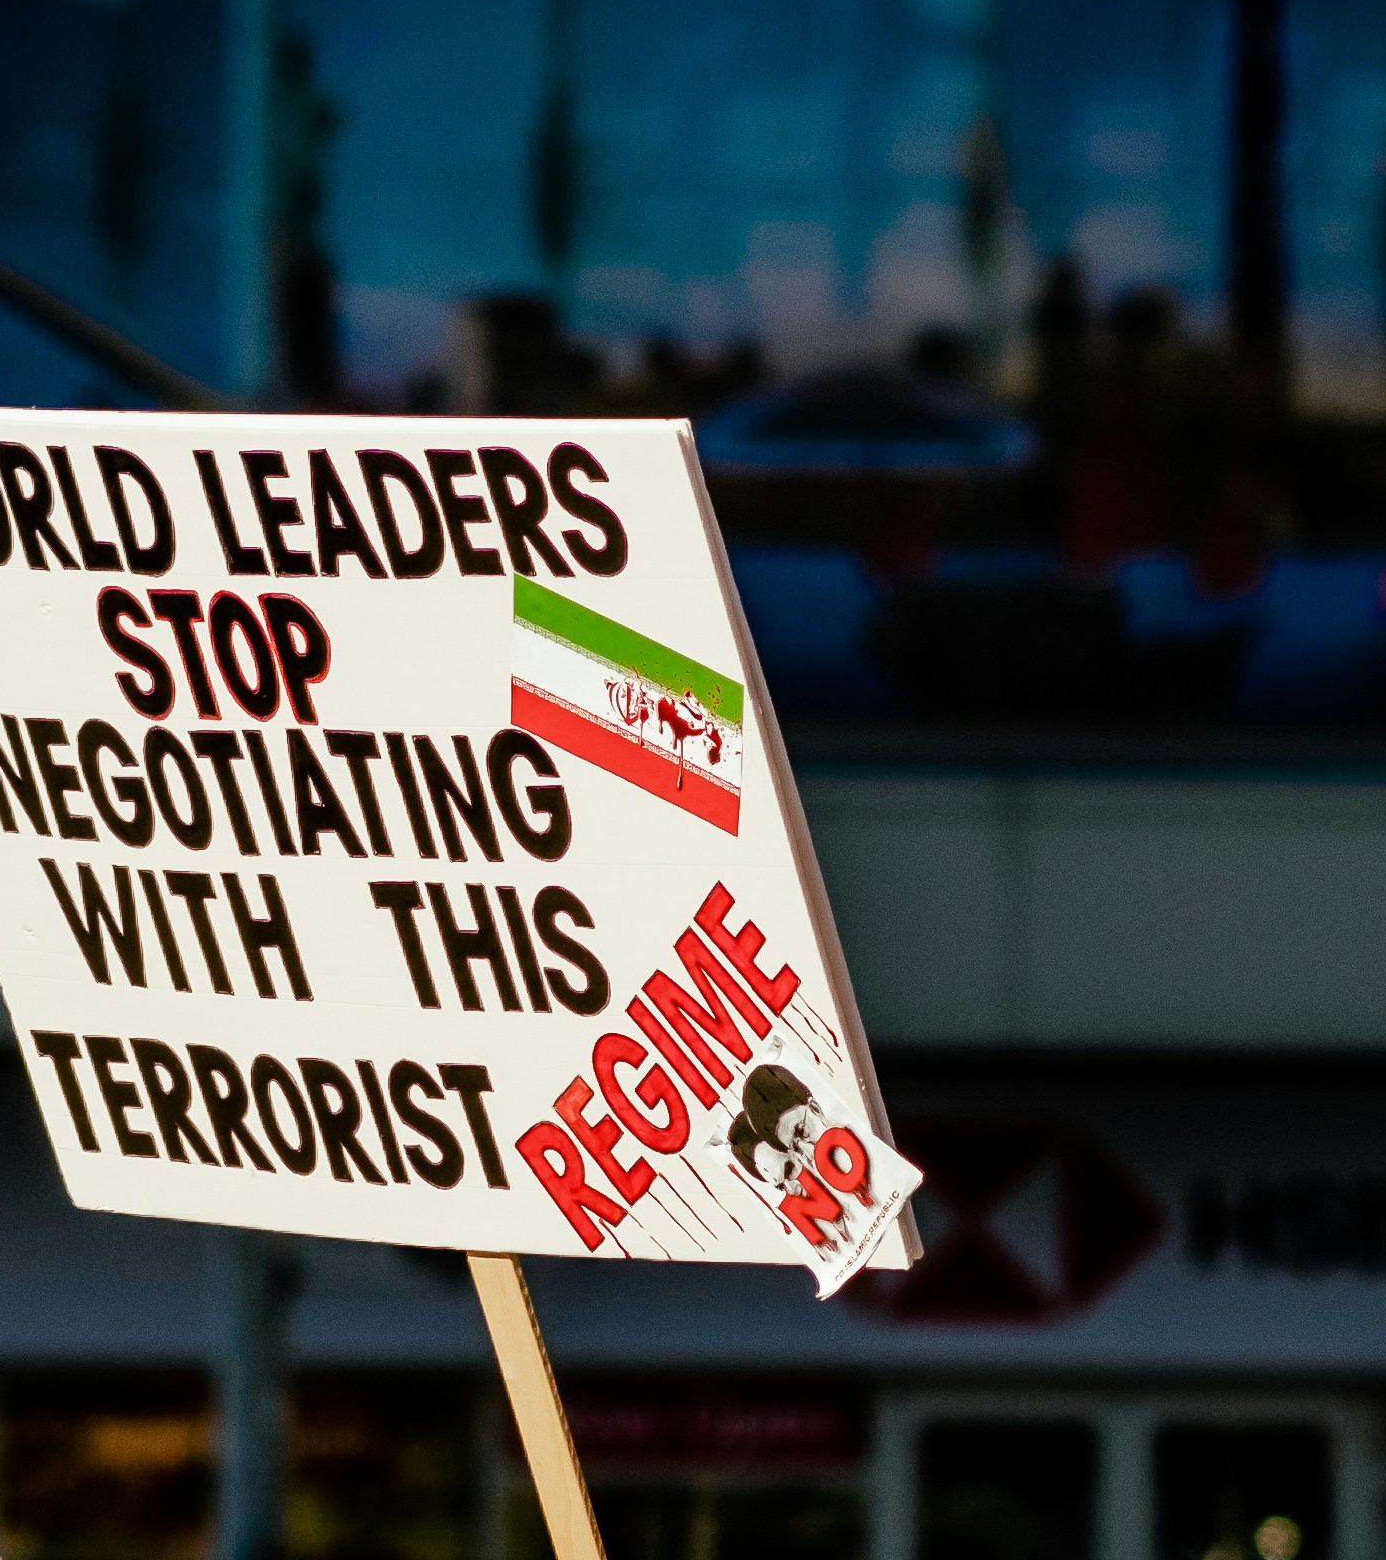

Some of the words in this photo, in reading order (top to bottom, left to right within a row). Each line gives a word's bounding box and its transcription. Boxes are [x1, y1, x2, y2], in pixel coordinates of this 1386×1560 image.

[193, 442, 629, 580] LEADERS
[96, 585, 333, 724] STOP
[38, 857, 316, 1002] WITH
[370, 880, 612, 1017] THIS
[30, 1030, 510, 1191] TERRORIST
[514, 880, 802, 1254] REGIME
[778, 1126, 870, 1247] NO
[868, 1190, 901, 1237] REPUBLIC
